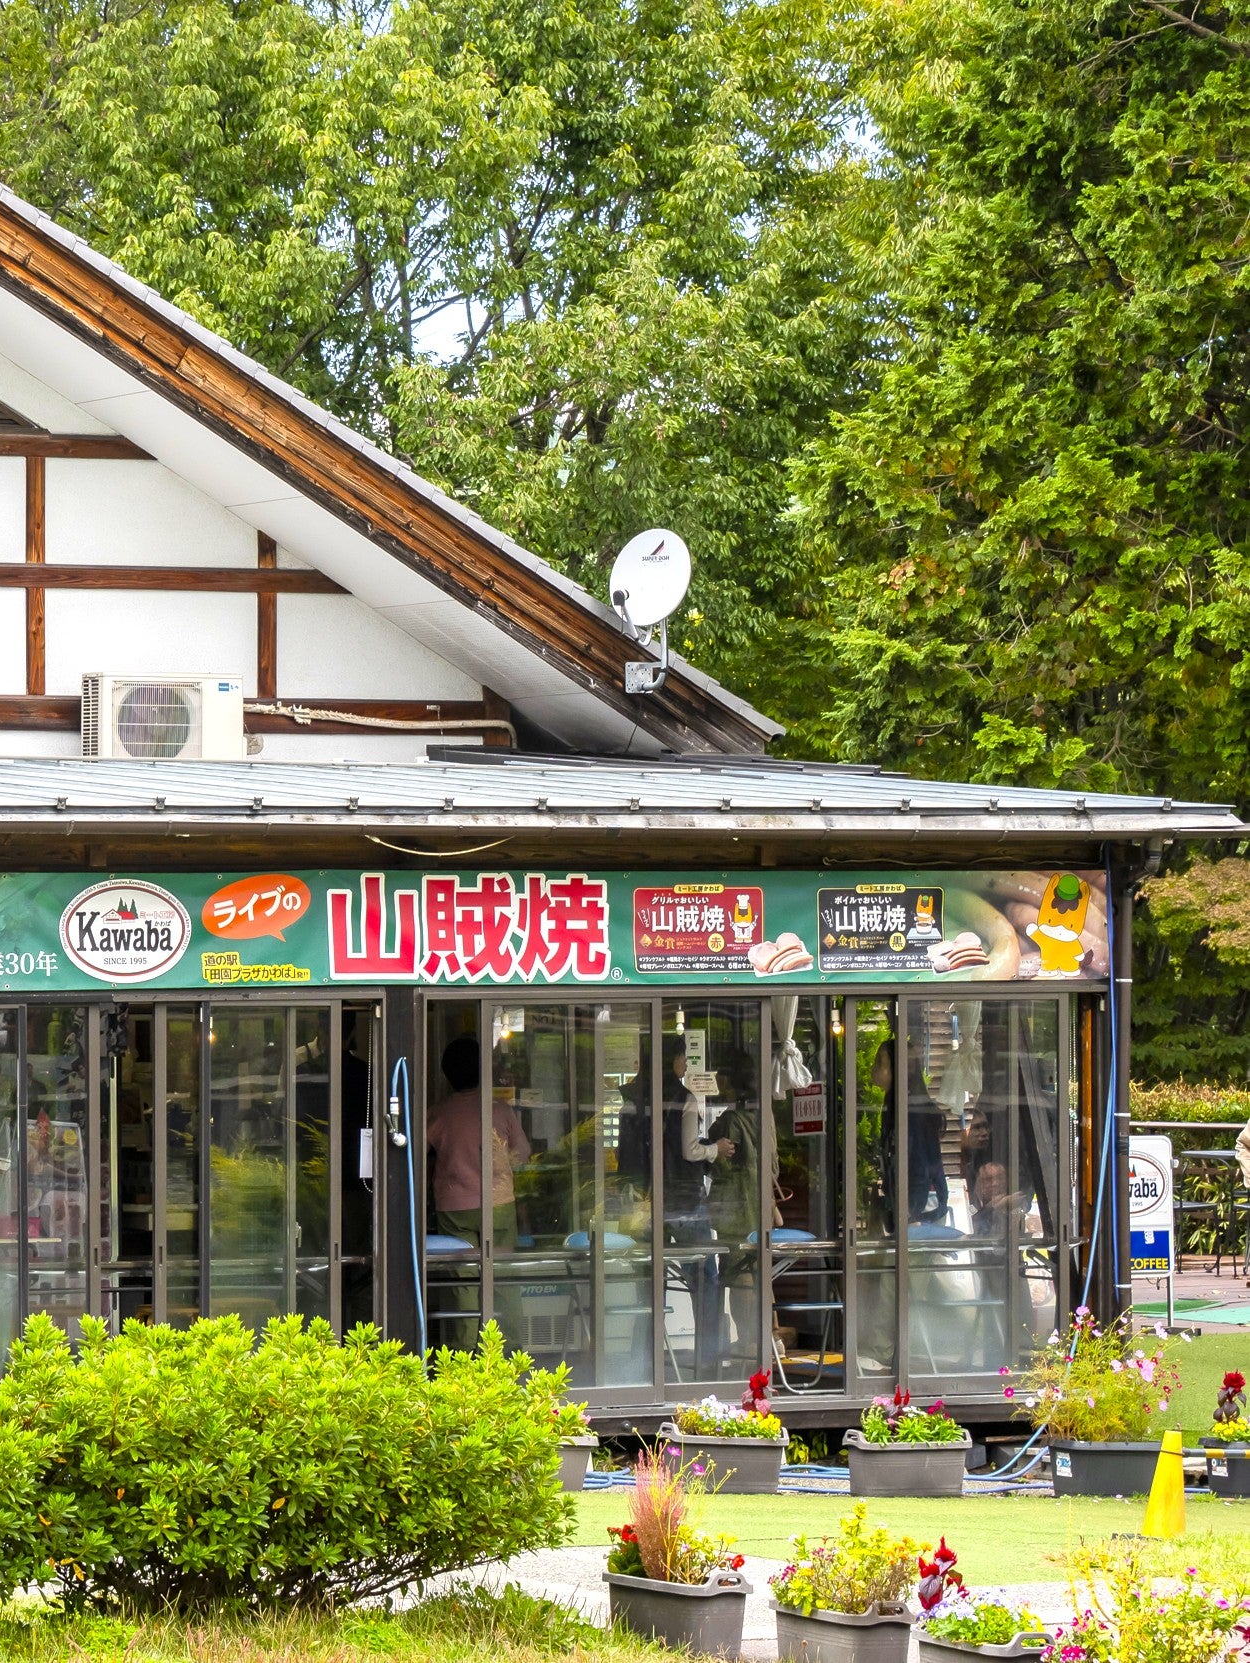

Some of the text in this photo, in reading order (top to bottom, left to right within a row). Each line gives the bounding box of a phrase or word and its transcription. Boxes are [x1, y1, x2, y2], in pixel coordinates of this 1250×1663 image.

[213, 885, 302, 929] ライブの
[652, 896, 709, 905] グリルでおいしい
[834, 896, 892, 905] ボイルでおいしい
[651, 905, 725, 933] 山賊焼
[835, 905, 907, 933] 山賊焼
[75, 911, 173, 952] Kawaba
[329, 875, 608, 979] 山賊焼
[654, 934, 675, 950] 金賞
[710, 937, 723, 949] 赤
[838, 934, 859, 949] 金賞
[892, 936, 903, 948] 黒
[103, 957, 147, 965] SINCE 1995
[204, 954, 238, 966] 道の駅
